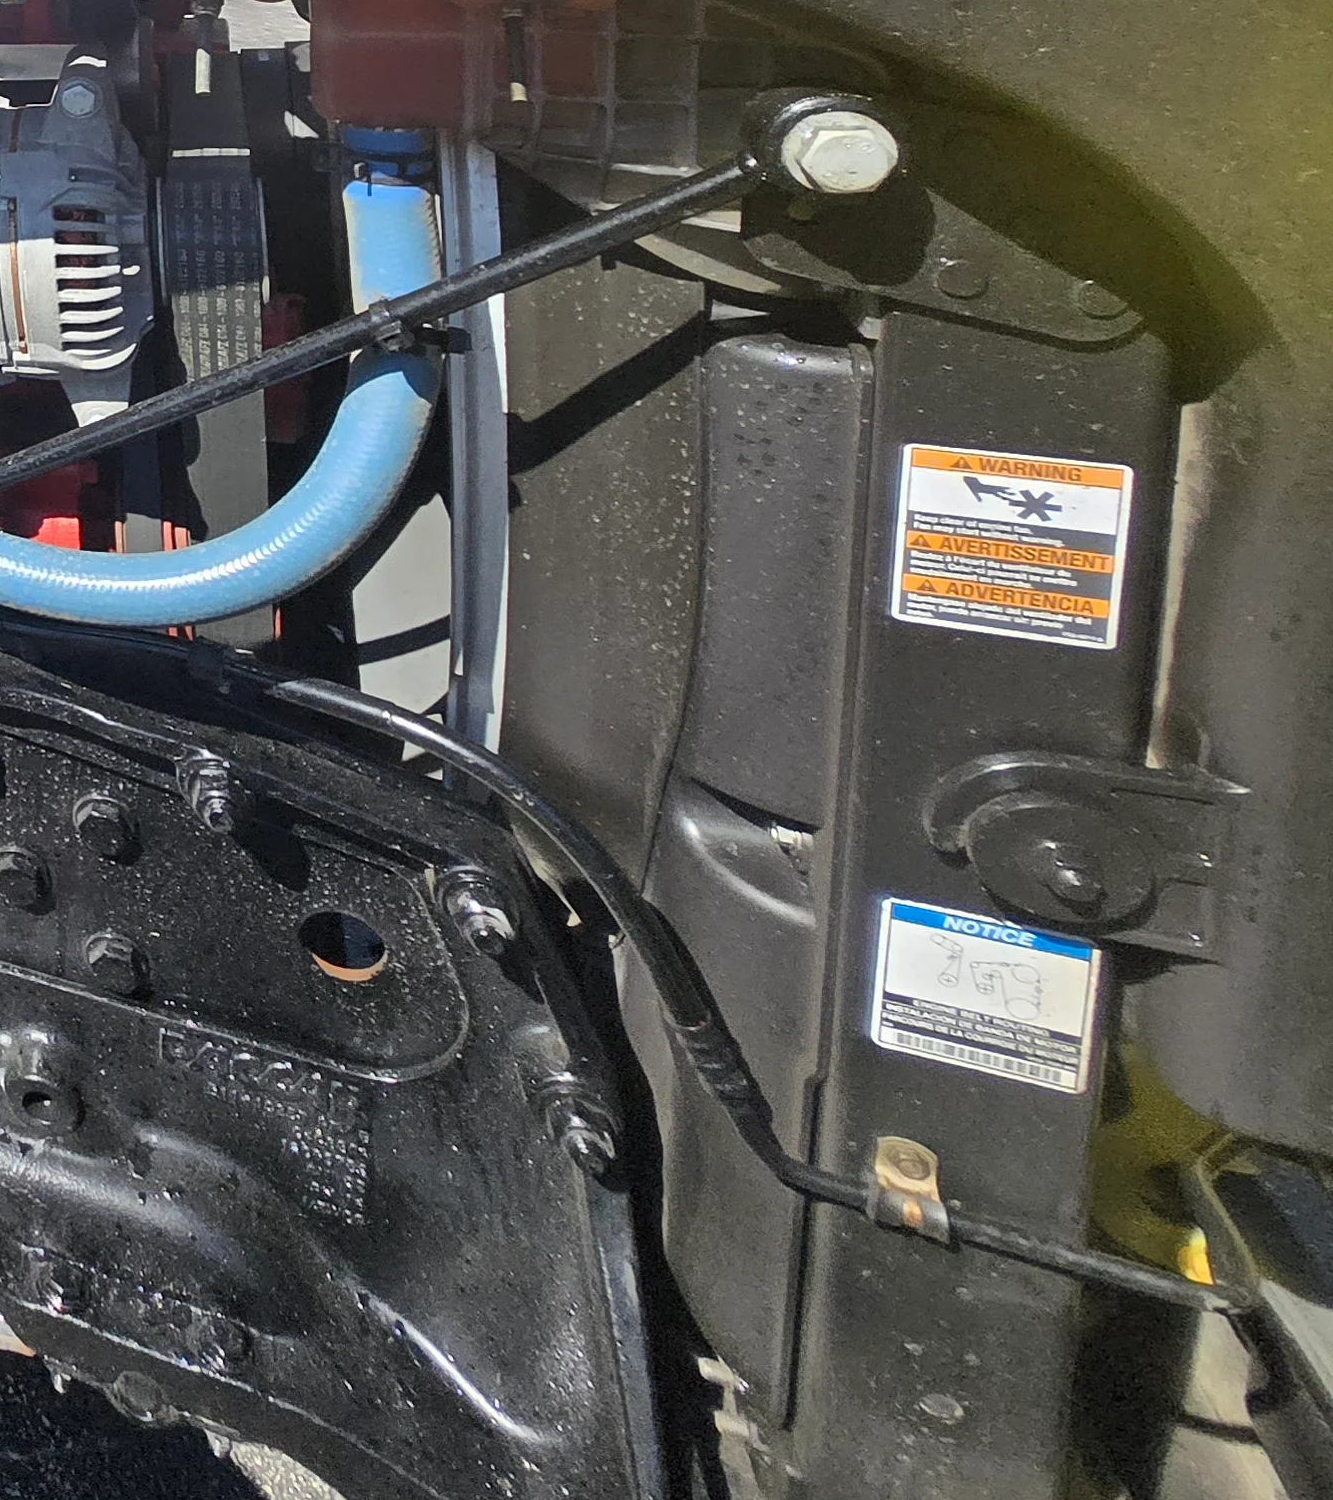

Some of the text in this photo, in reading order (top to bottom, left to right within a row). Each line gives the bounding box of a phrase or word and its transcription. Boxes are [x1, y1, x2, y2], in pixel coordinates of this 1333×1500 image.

[979, 457, 1083, 482] WARNING
[939, 536, 1111, 571] AVERTISSEMENT
[945, 582, 1094, 615] ADVERTENCIA
[942, 914, 1040, 948] NOTICE
